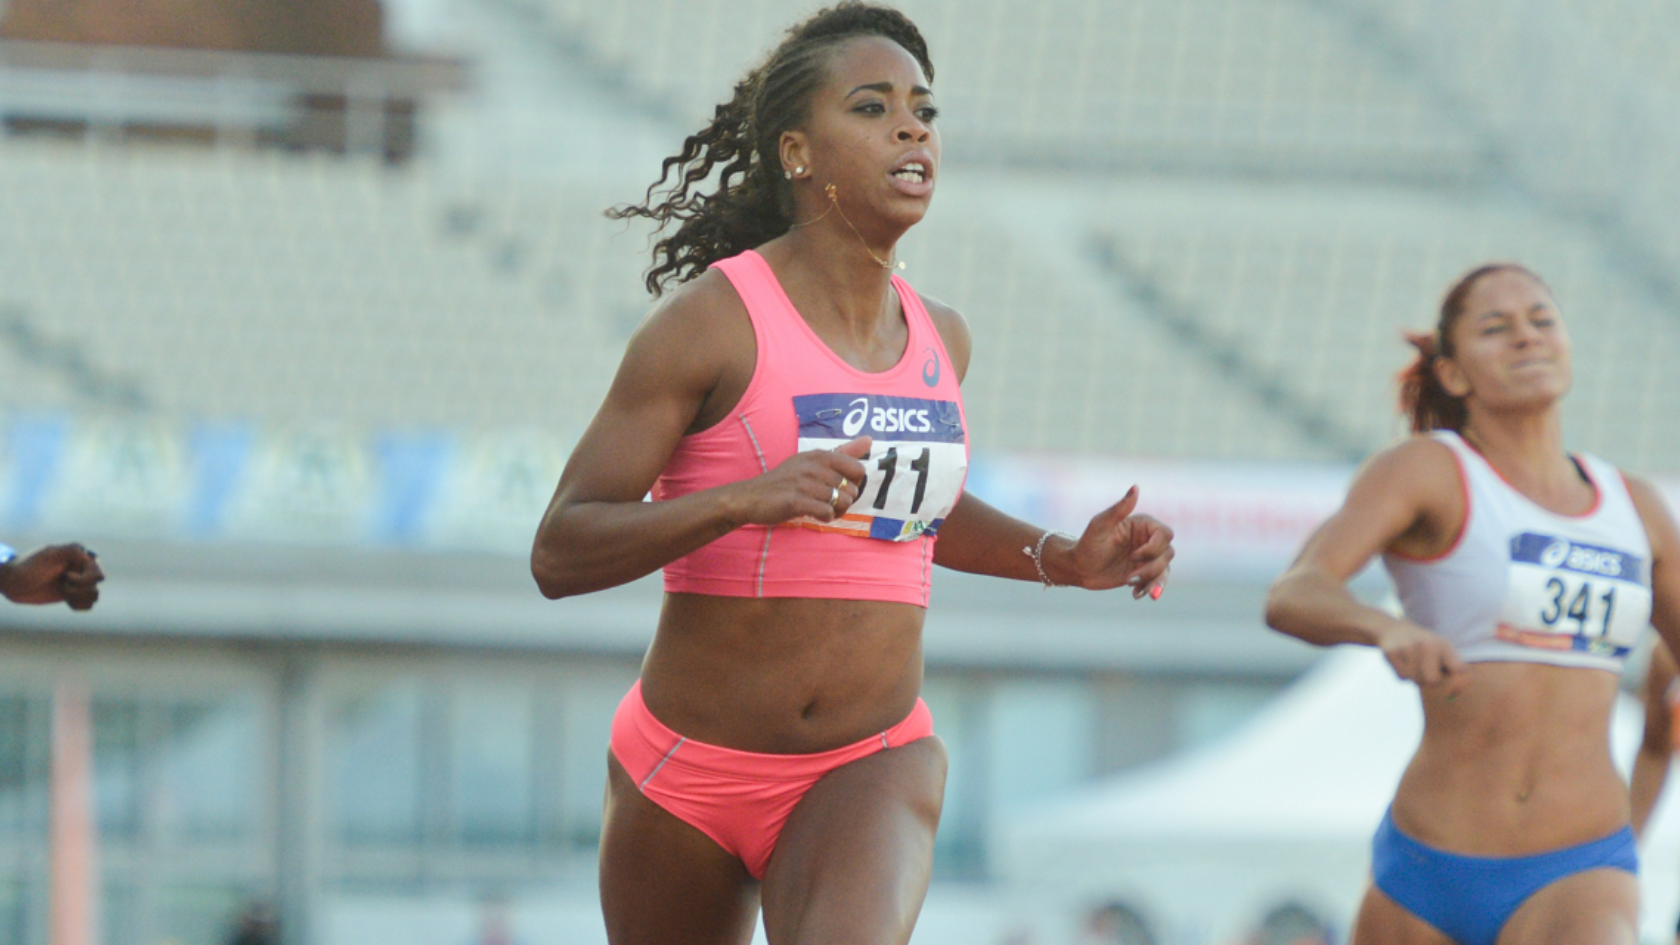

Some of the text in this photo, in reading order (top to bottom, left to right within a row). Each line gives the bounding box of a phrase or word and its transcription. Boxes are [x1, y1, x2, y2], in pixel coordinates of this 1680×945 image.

[870, 407, 931, 432] asics
[851, 447, 930, 514] 11
[1541, 577, 1614, 636] 341
